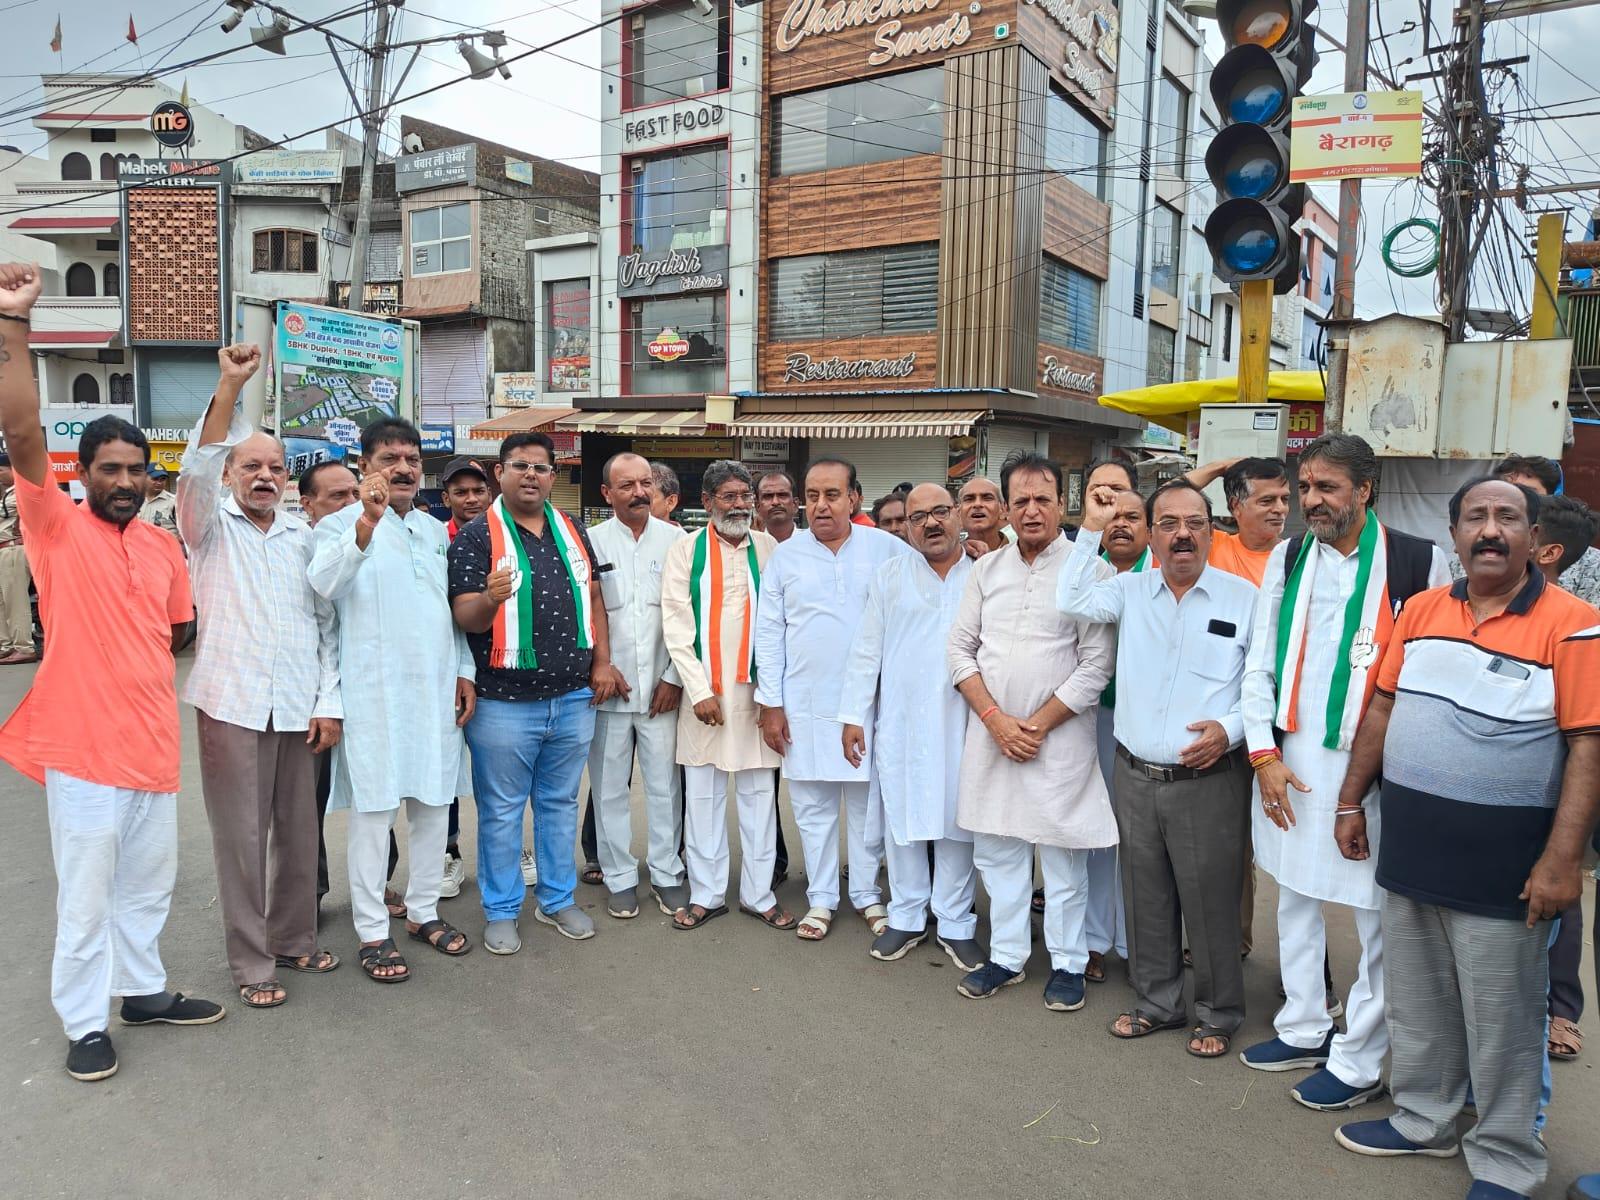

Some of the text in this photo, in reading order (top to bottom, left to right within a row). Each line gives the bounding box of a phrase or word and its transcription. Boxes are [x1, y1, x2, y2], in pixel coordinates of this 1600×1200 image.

[776, 0, 939, 51] Chanc
[868, 12, 972, 66] Sweets
[1062, 41, 1104, 100] Sweets
[625, 104, 725, 144] FAST FOOD
[1318, 133, 1394, 152] बैरागढ़
[119, 160, 220, 176] Mahek Mobile
[620, 247, 702, 287] Jagdish
[650, 345, 662, 353] TOP
[669, 344, 687, 352] TOWN
[784, 352, 917, 383] Restaurant
[1042, 355, 1096, 393] Restaurant
[54, 421, 87, 439] op
[143, 428, 181, 441] MAHEK
[51, 462, 77, 472] शाओ
